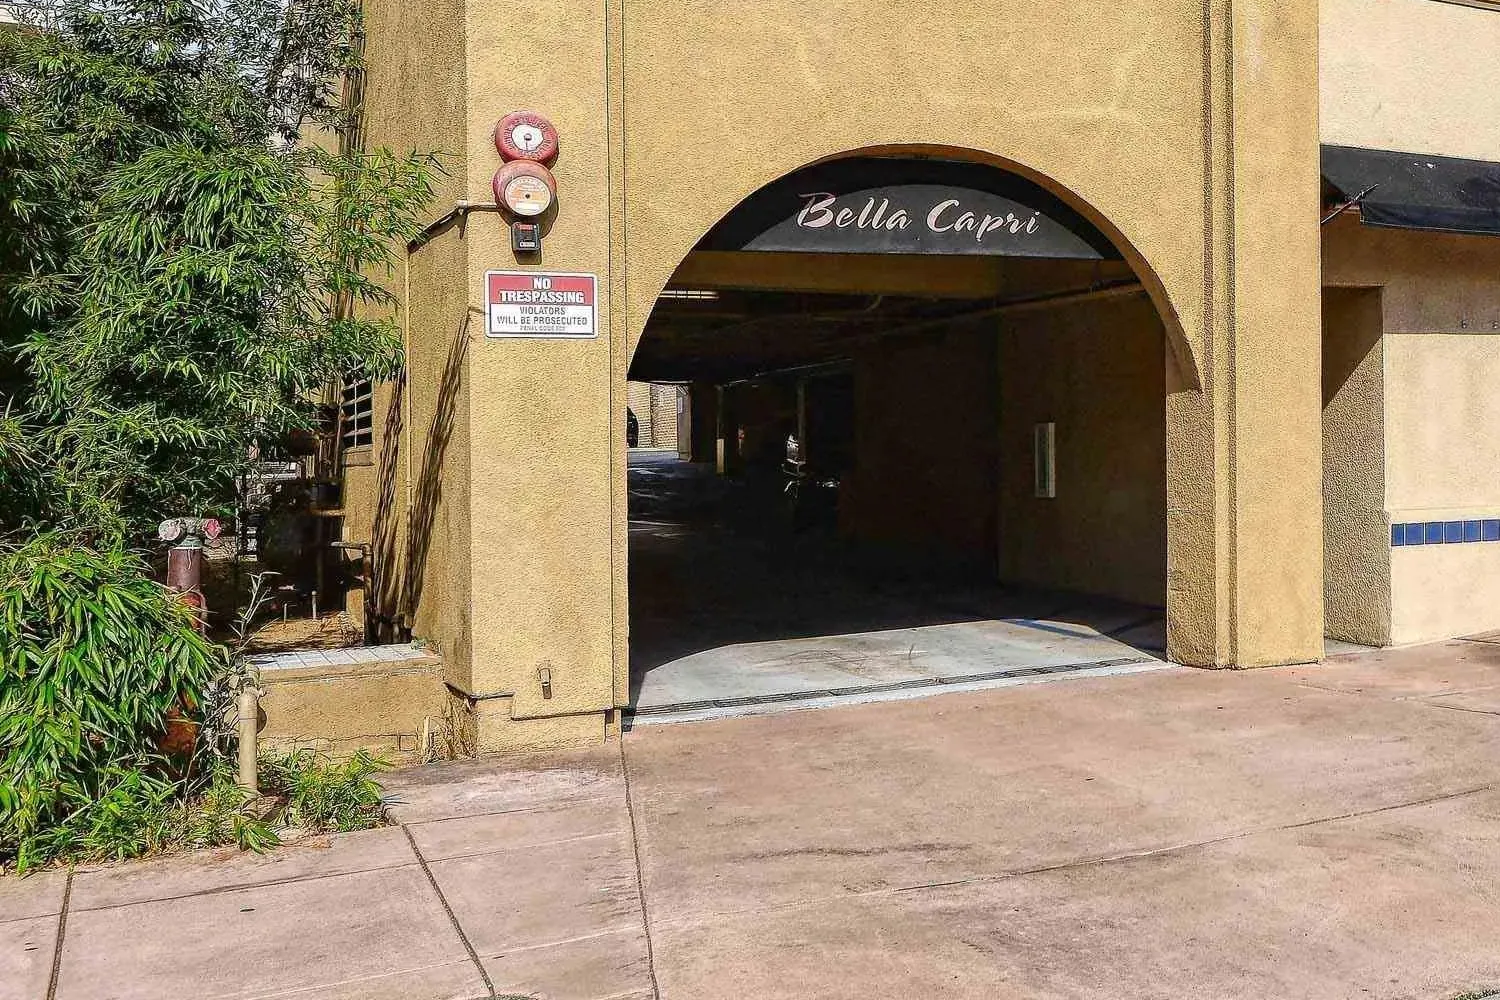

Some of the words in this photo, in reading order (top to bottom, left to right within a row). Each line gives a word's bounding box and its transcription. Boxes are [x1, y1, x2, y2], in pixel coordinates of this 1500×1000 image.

[797, 192, 911, 231] Bella
[926, 199, 1041, 242] Capri
[533, 277, 552, 290] NO
[499, 290, 585, 304] TRESPASSING
[520, 306, 566, 315] VIOLATORS
[497, 315, 518, 325] WILL
[520, 316, 532, 325] BE
[533, 316, 588, 326] PROSECUTED
